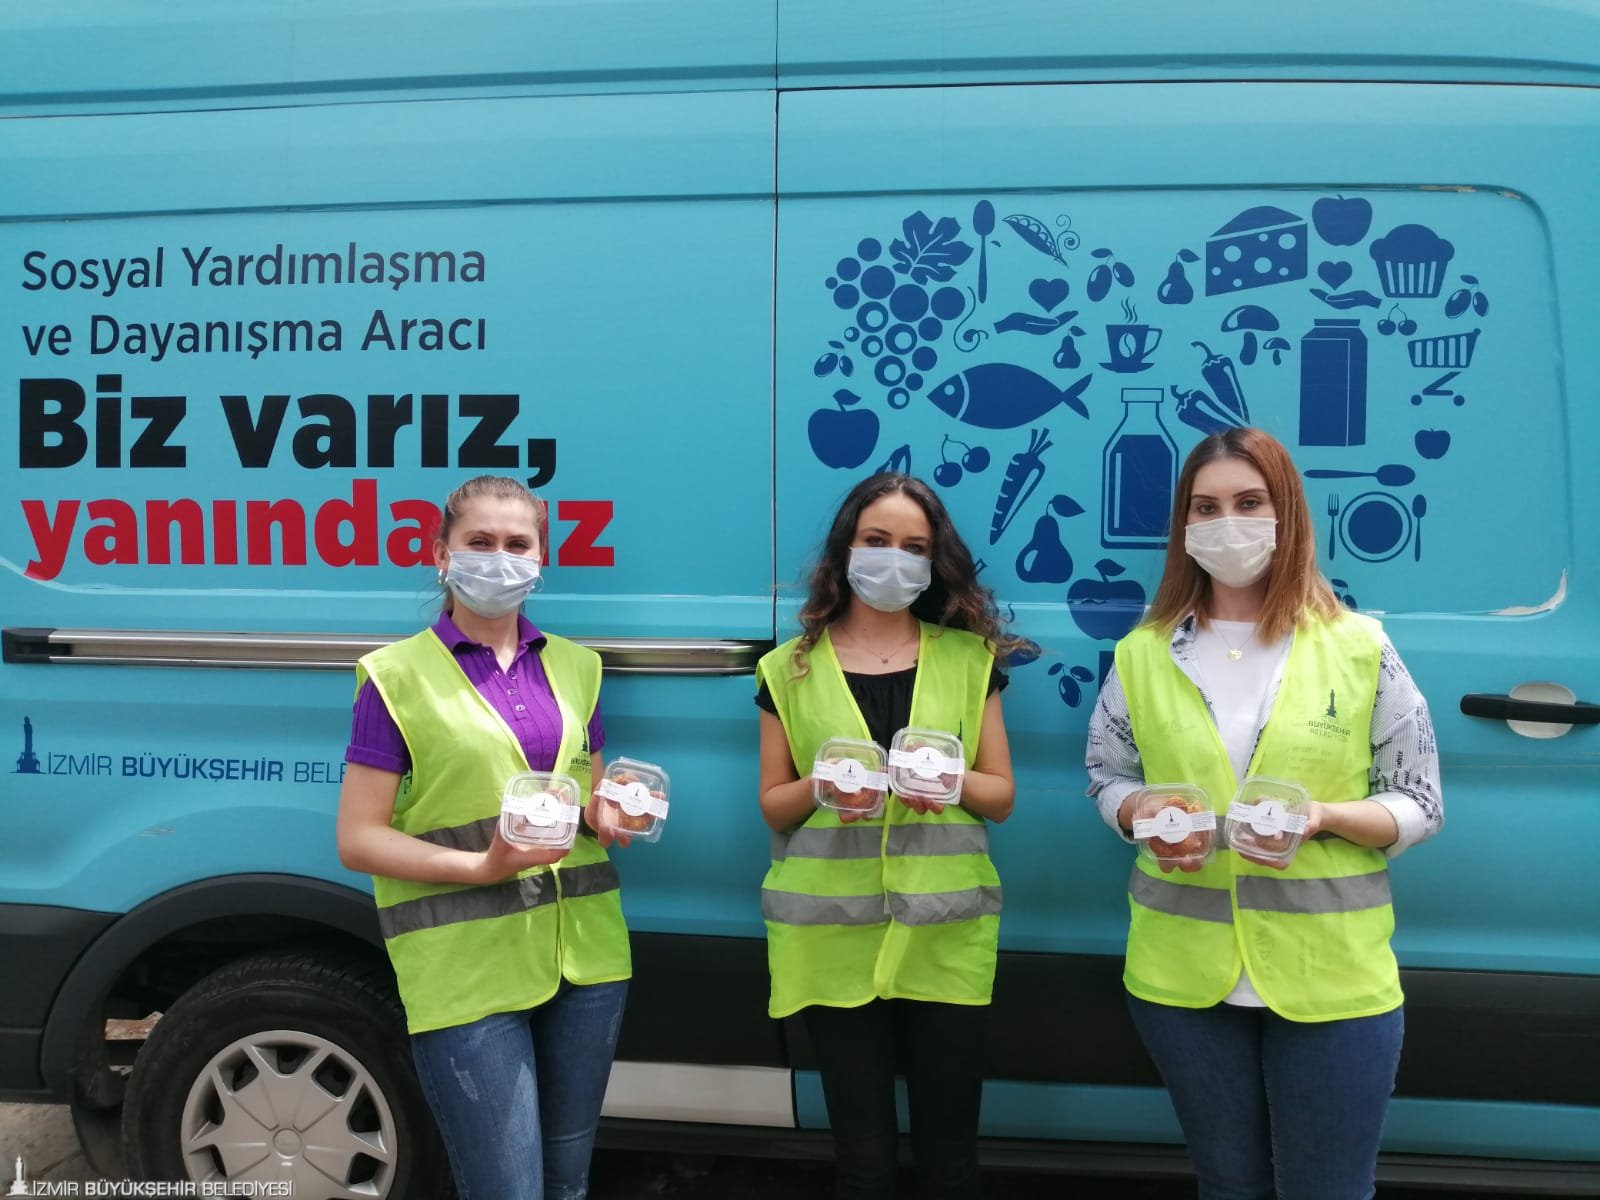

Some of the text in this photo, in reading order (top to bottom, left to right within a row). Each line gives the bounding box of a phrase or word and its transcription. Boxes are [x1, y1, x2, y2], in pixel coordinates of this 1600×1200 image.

[21, 242, 486, 297] Sosyal Yardımlaşma
[22, 310, 486, 362] ve Dayanışma Aracı
[19, 374, 557, 488] Biz varız,
[20, 478, 615, 581] yanındaz
[48, 751, 112, 776] İZMİR
[121, 752, 284, 783] BÜYÜKŞEHİR
